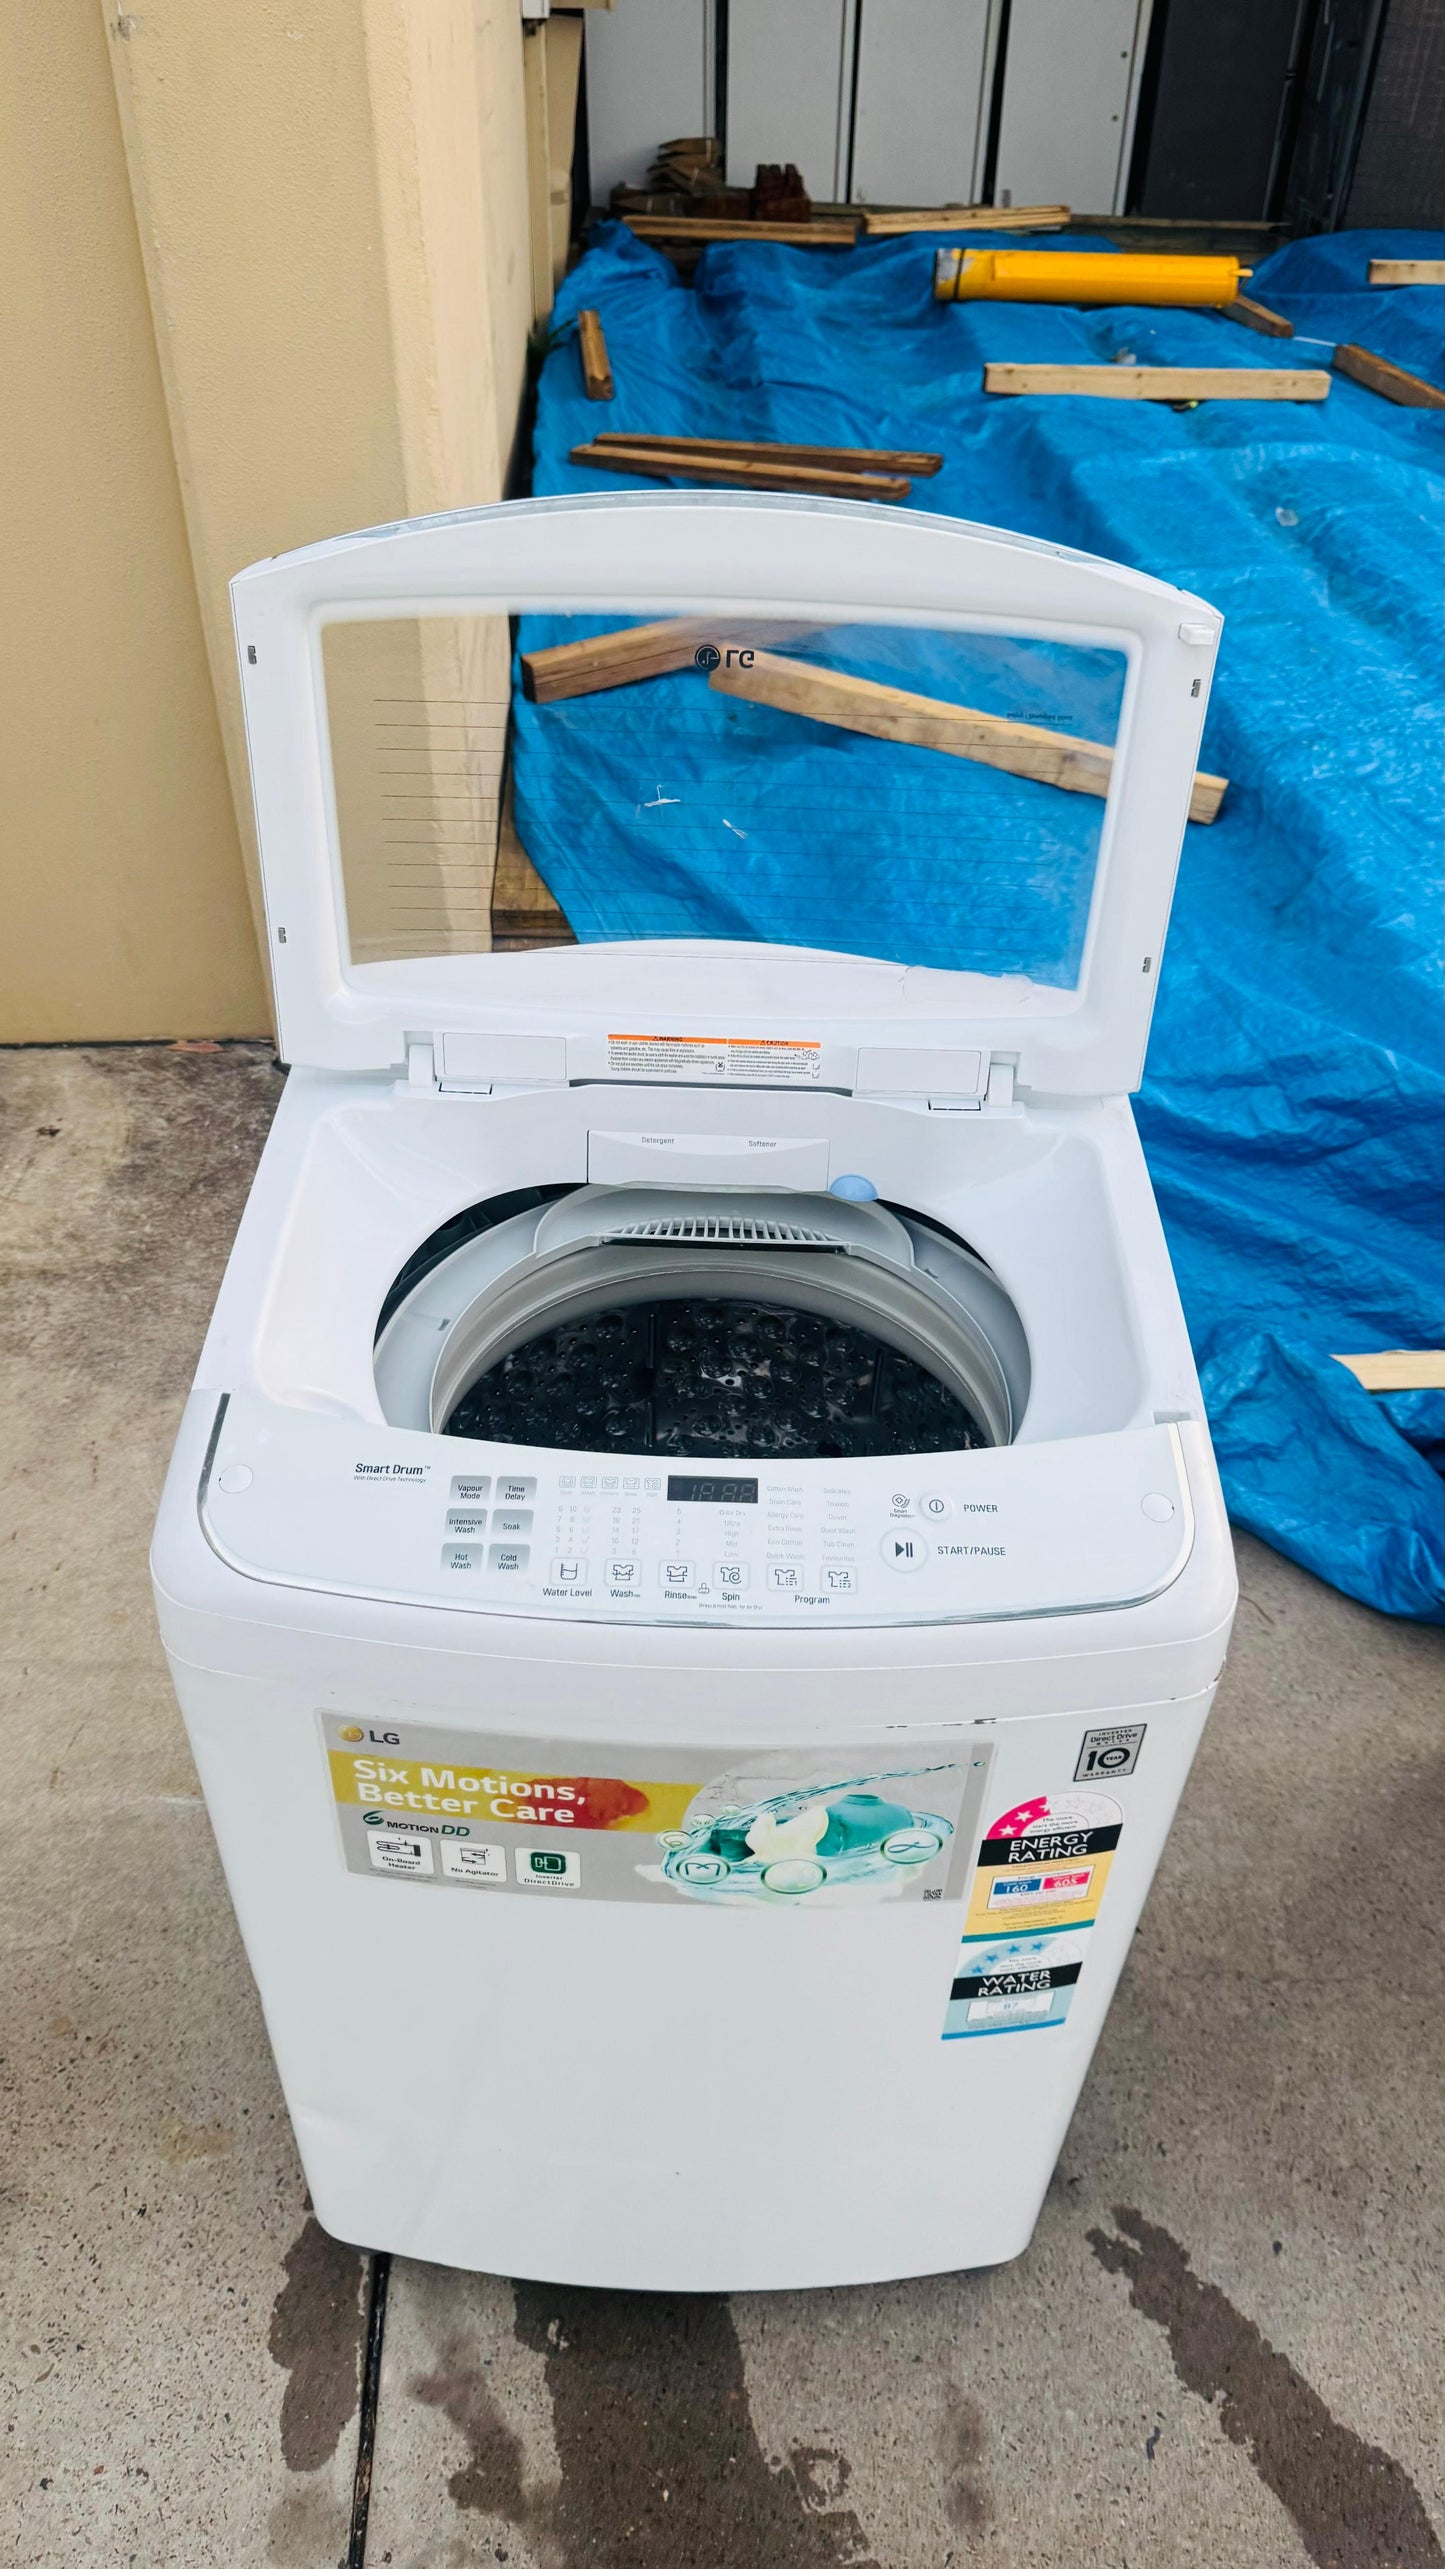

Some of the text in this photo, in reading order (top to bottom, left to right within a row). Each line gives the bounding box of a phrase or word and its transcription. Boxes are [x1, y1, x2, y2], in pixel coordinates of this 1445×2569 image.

[641, 1137, 674, 1145] Detergent
[748, 1140, 776, 1148] Softener
[355, 1463, 390, 1474] Smart
[457, 1484, 483, 1493] Vapour
[508, 1485, 525, 1493] Time
[505, 1493, 525, 1501] Delay
[964, 1504, 998, 1513] POWER
[454, 1526, 475, 1534] Wash
[937, 1546, 1006, 1556] START/PAUSE
[454, 1553, 468, 1561] Hot
[497, 1562, 519, 1570] Wash
[542, 1588, 592, 1597] Water Level
[610, 1589, 634, 1598] Wash
[664, 1591, 687, 1599] Rinse
[722, 1592, 740, 1601] Spin
[795, 1595, 830, 1604] Program
[369, 1730, 400, 1745] LG
[1086, 1748, 1130, 1771] 10
[353, 1760, 586, 1805] Six Motions,
[357, 1782, 574, 1823] Better Care
[1010, 1831, 1094, 1851] ENERGY
[1008, 1844, 1088, 1863] RATING
[382, 1856, 420, 1865] On-Board
[388, 1862, 416, 1870] Heater
[465, 1869, 499, 1877] Agitator
[1006, 1884, 1028, 1893] 160
[982, 1970, 1051, 1986] WATER
[978, 1979, 1051, 1997] RATING
